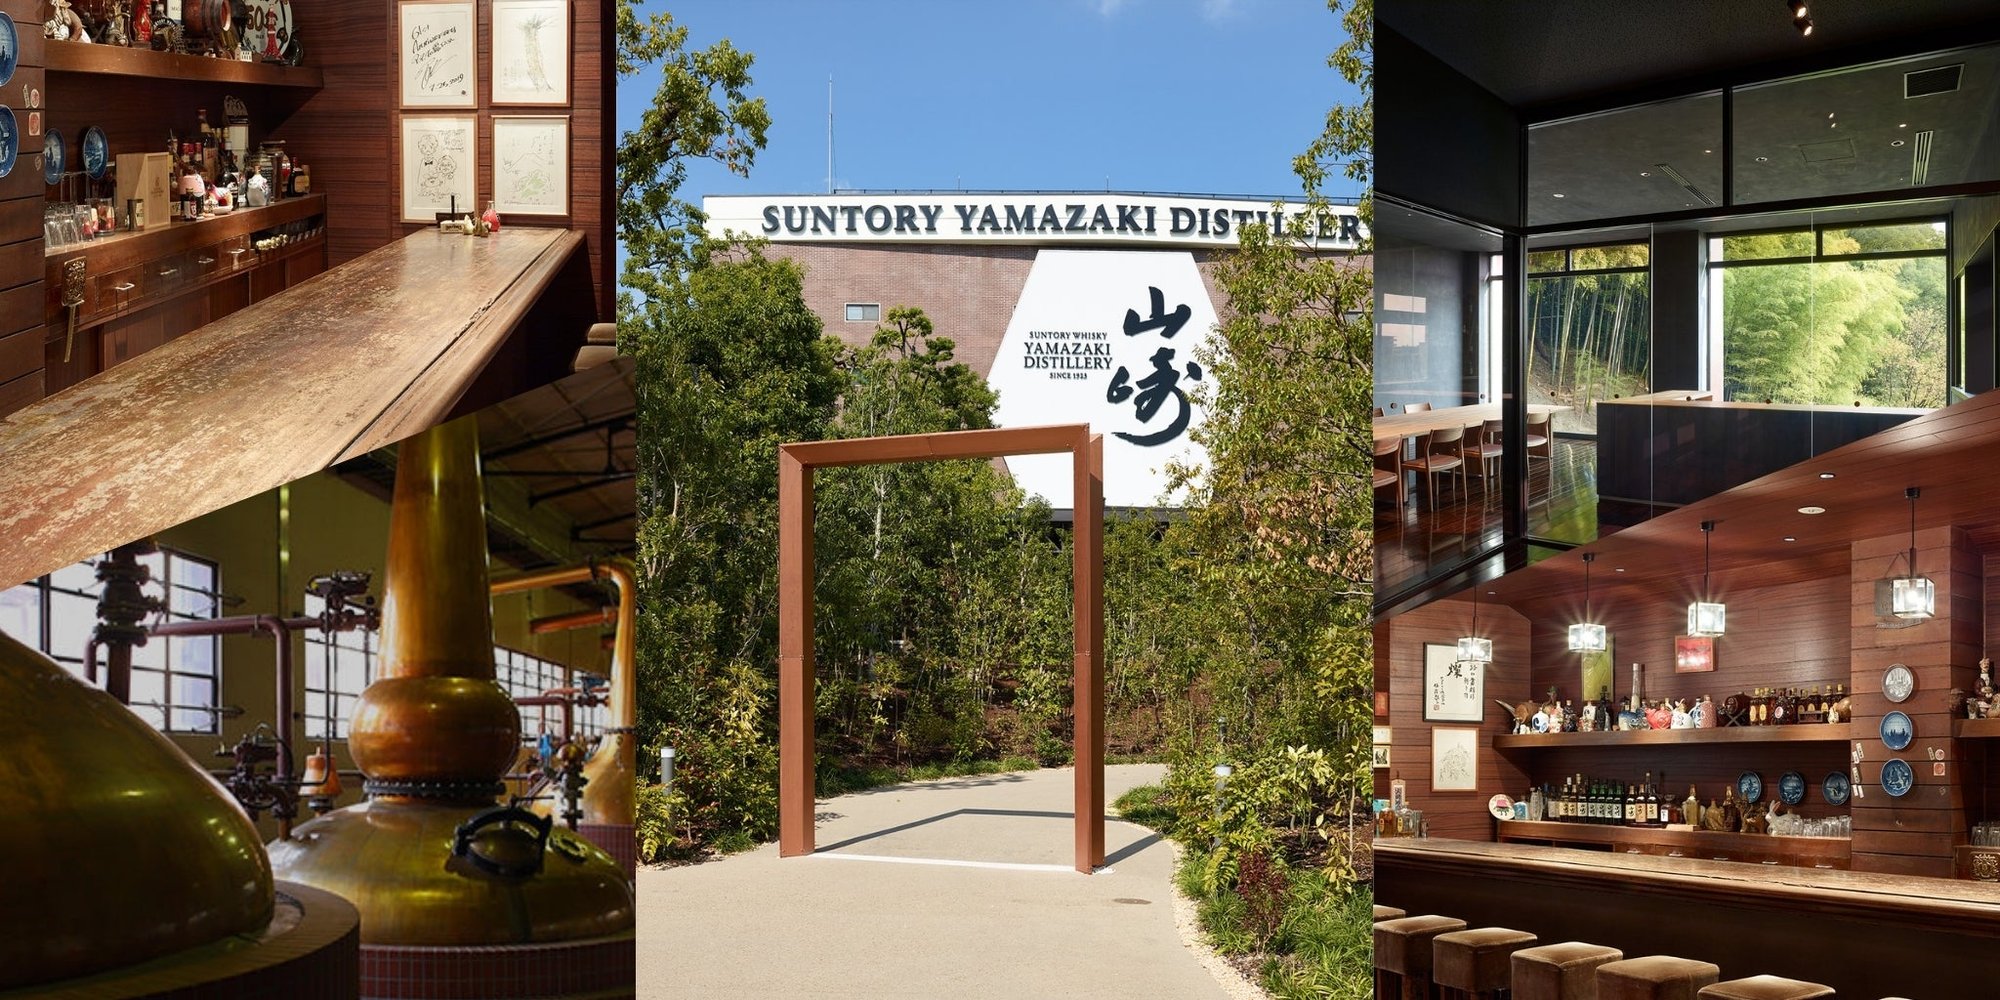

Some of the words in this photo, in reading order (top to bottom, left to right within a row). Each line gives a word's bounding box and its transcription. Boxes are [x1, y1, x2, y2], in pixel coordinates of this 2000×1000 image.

[762, 204, 943, 233] SUNTORY
[954, 204, 1157, 232] YAMAZAKI
[1170, 206, 1364, 241] DISTILLER
[1029, 331, 1071, 340] SUNTORY
[1072, 331, 1108, 341] WHISKY
[1024, 341, 1111, 356] YAMAZAKI
[1024, 355, 1113, 370] DISTILLERY
[1106, 286, 1202, 446] 山崎
[1049, 372, 1071, 380] SINCE
